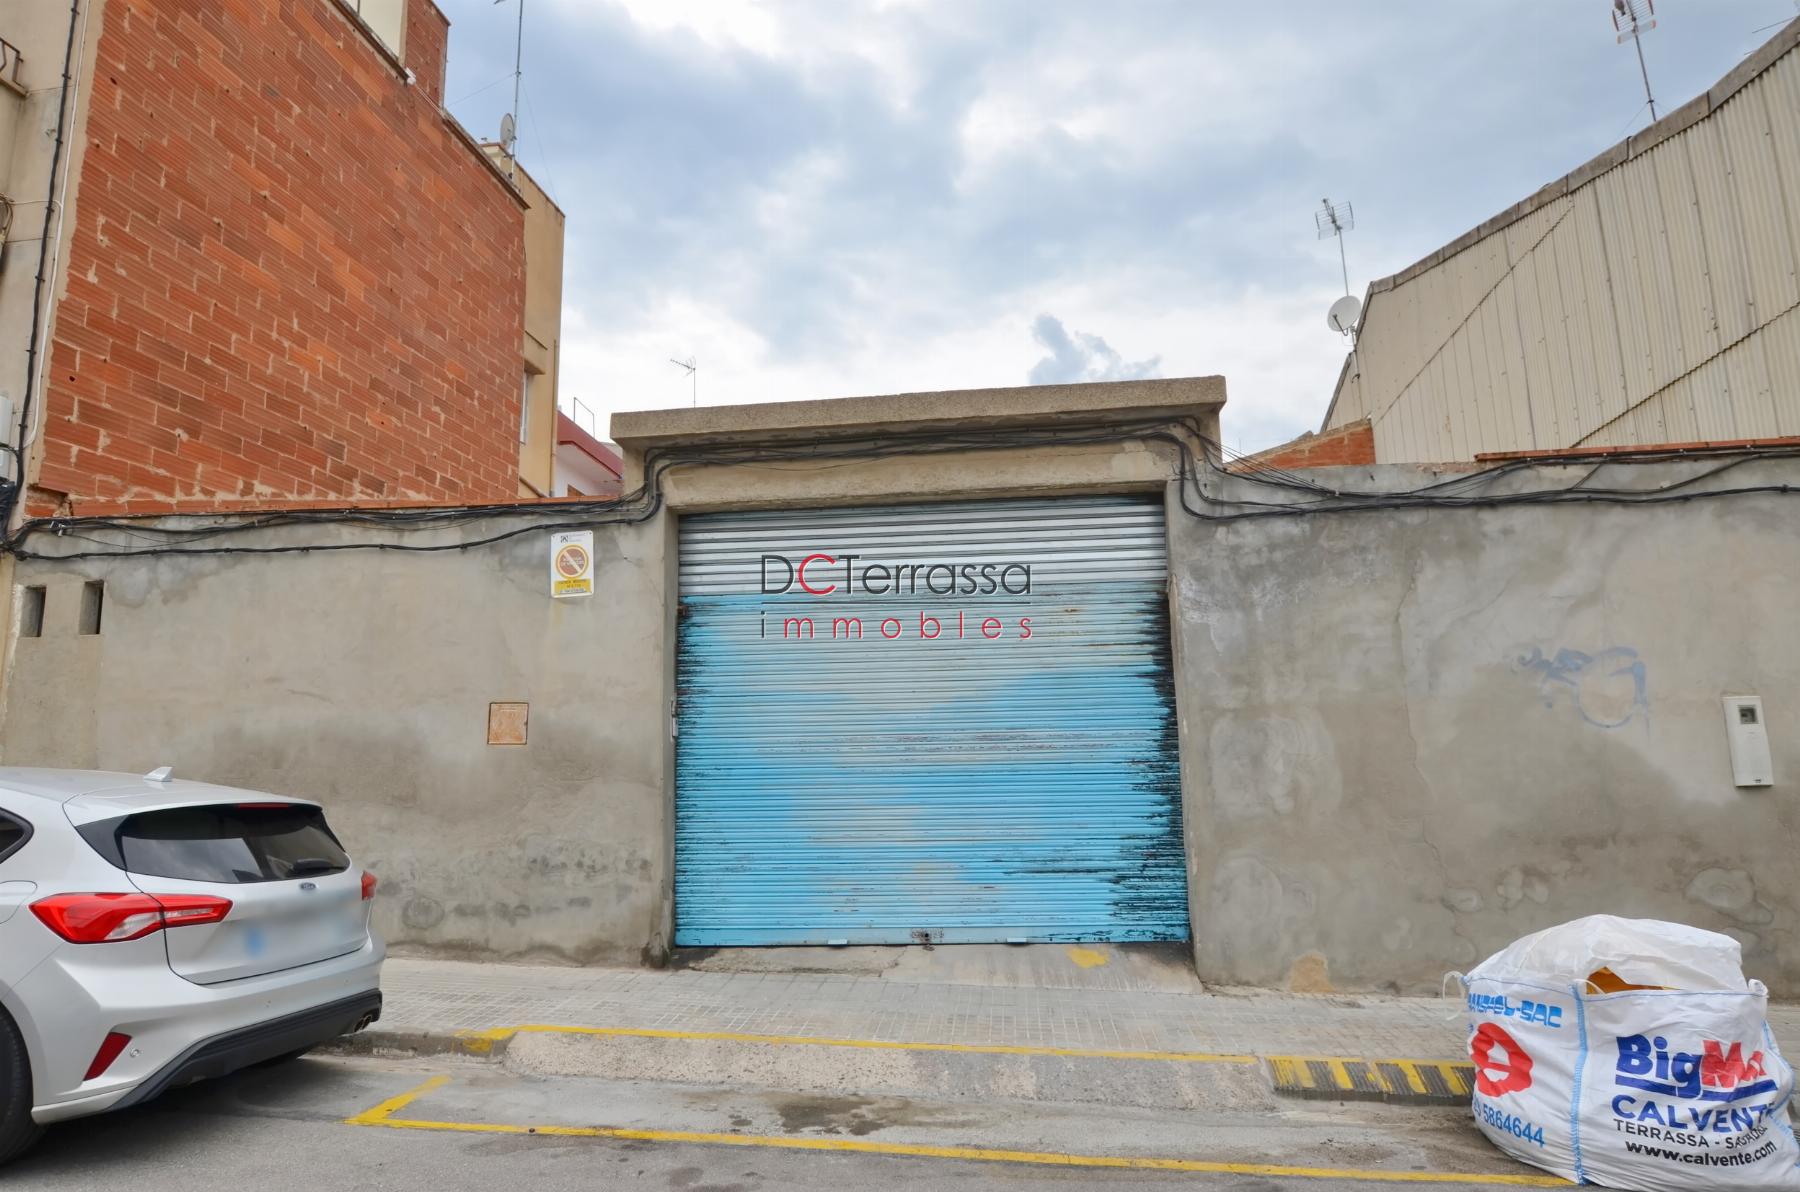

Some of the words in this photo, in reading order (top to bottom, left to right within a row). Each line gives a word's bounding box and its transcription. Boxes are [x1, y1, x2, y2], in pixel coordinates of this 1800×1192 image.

[1615, 1034, 1768, 1098] BigMa
[1483, 1103, 1545, 1148] 5864644
[1612, 1094, 1775, 1132] CALVENT
[1613, 1118, 1710, 1148] TERRASSA
[1625, 1140, 1777, 1167] www.calvente.com
